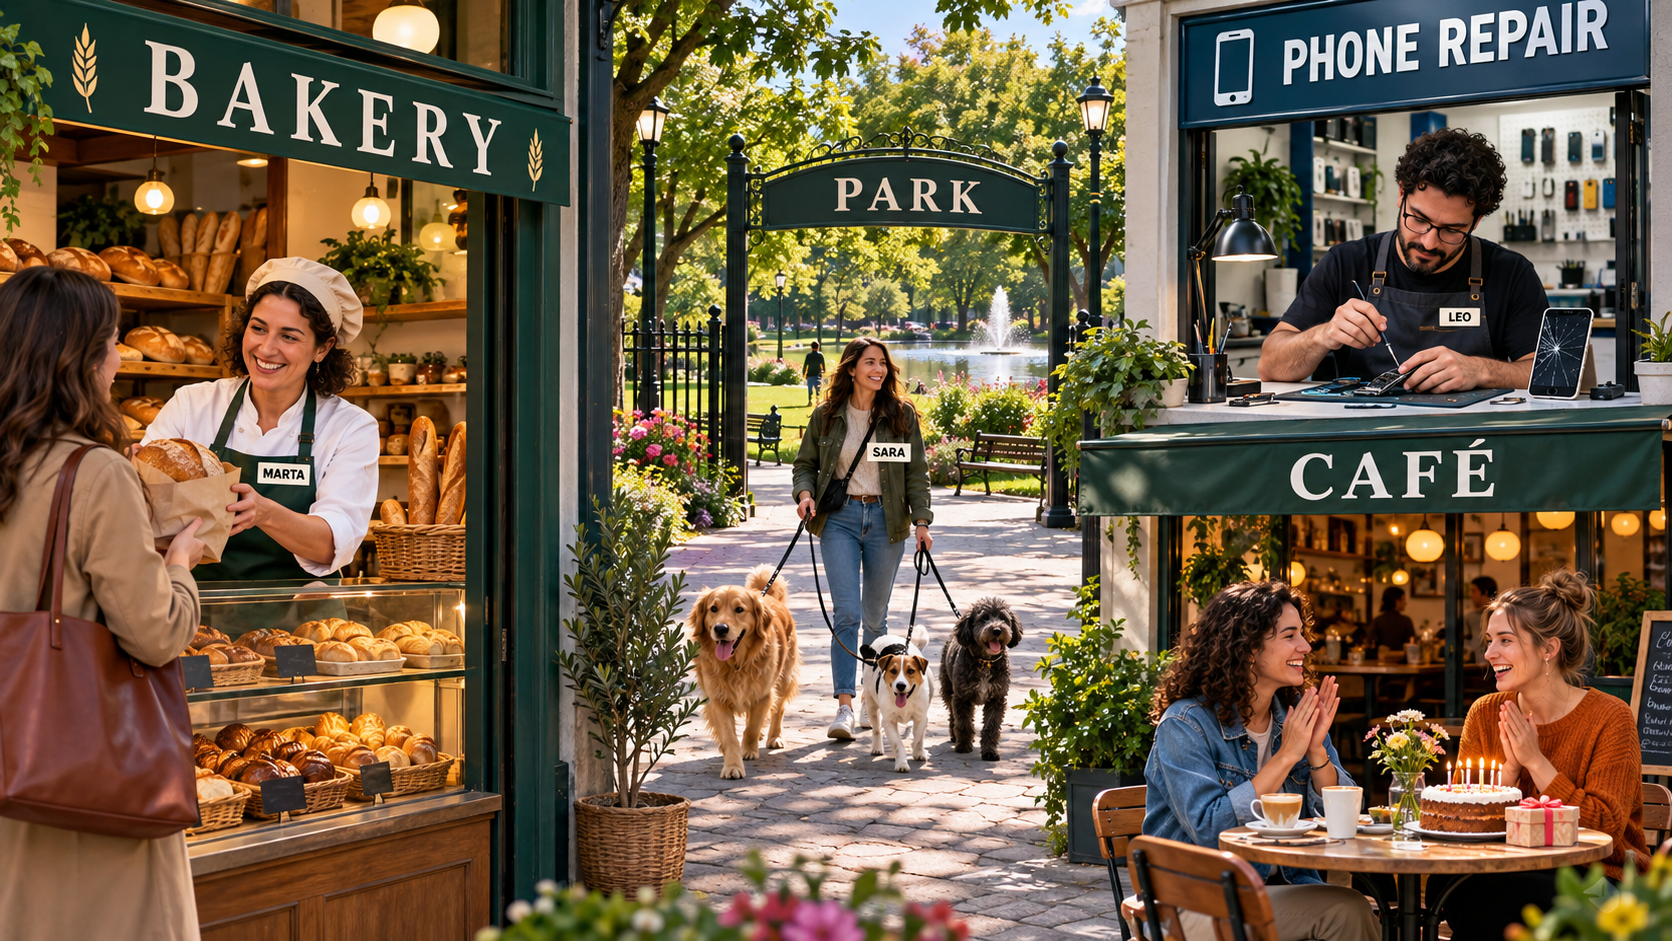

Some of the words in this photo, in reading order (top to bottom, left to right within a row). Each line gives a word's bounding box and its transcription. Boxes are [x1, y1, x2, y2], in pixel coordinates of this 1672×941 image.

[1283, 22, 1420, 86] PHONE
[1438, 0, 1609, 68] REPAIR
[143, 39, 502, 177] BAKERY
[834, 177, 983, 215] PARK
[1448, 311, 1472, 322] LEO
[872, 446, 906, 458] SARA
[1290, 438, 1495, 501] CAFÉ
[262, 467, 305, 481] MARTA
